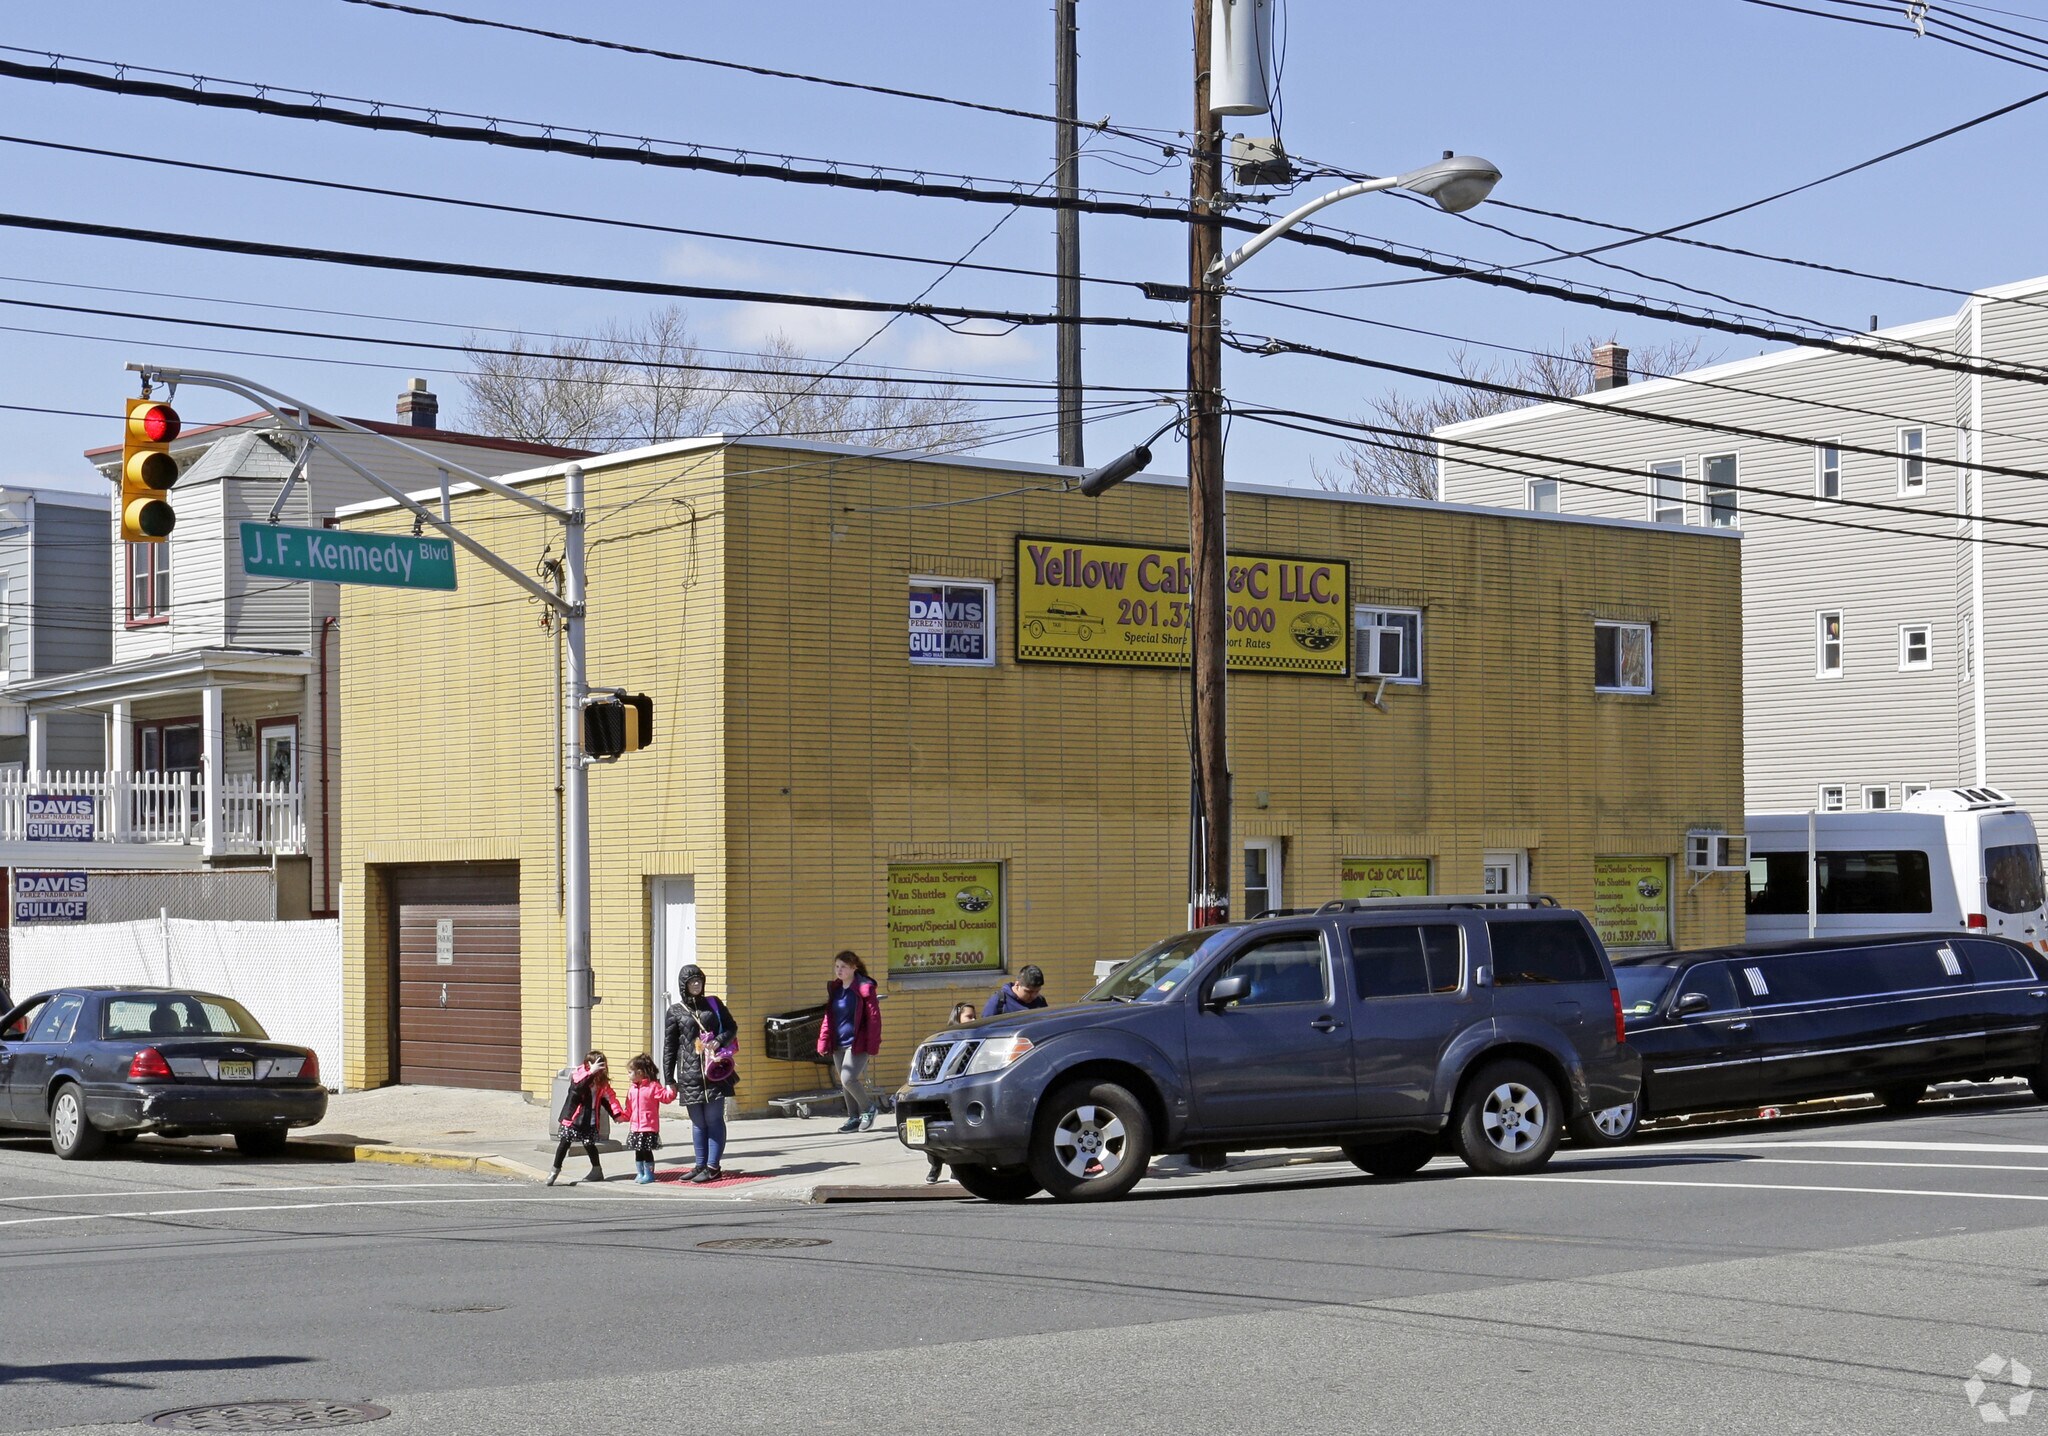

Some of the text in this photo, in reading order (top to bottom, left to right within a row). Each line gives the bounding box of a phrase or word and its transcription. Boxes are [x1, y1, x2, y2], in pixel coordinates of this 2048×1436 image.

[307, 535, 413, 582] Kennedy
[419, 542, 449, 561] Blvd
[1027, 545, 1128, 590] Yellow
[1138, 554, 1192, 594] Cab
[1279, 564, 1340, 605] LLC.
[909, 600, 982, 621] DAVIS
[1306, 627, 1324, 636] 24
[910, 633, 980, 653] GULLACE
[1124, 631, 1159, 645] Special
[1161, 633, 1188, 645] Shore
[1245, 638, 1272, 649] Rates
[28, 800, 92, 814] DAVIS
[28, 824, 91, 838] GULLACE
[1368, 868, 1384, 880] Cab
[1386, 868, 1405, 880] C&C
[1407, 868, 1426, 880] LLC.
[1594, 864, 1652, 874] Taxi/Sedan Services
[891, 872, 977, 884] Taxi/Sedan Services
[1594, 878, 1631, 886] Van Shuttles
[18, 878, 86, 892] DAVIS
[891, 889, 947, 900] Van Shuttles
[18, 902, 84, 917] GULLACE
[892, 906, 936, 916] Limosines
[1594, 904, 1666, 914] Airport/Special Occasion
[892, 919, 997, 934] Airport/Special Occasion
[1595, 918, 1638, 928] Transportation
[892, 936, 956, 949] Transportation
[1601, 930, 1657, 942] 201.339.5000
[904, 951, 984, 967] 201.339.5000
